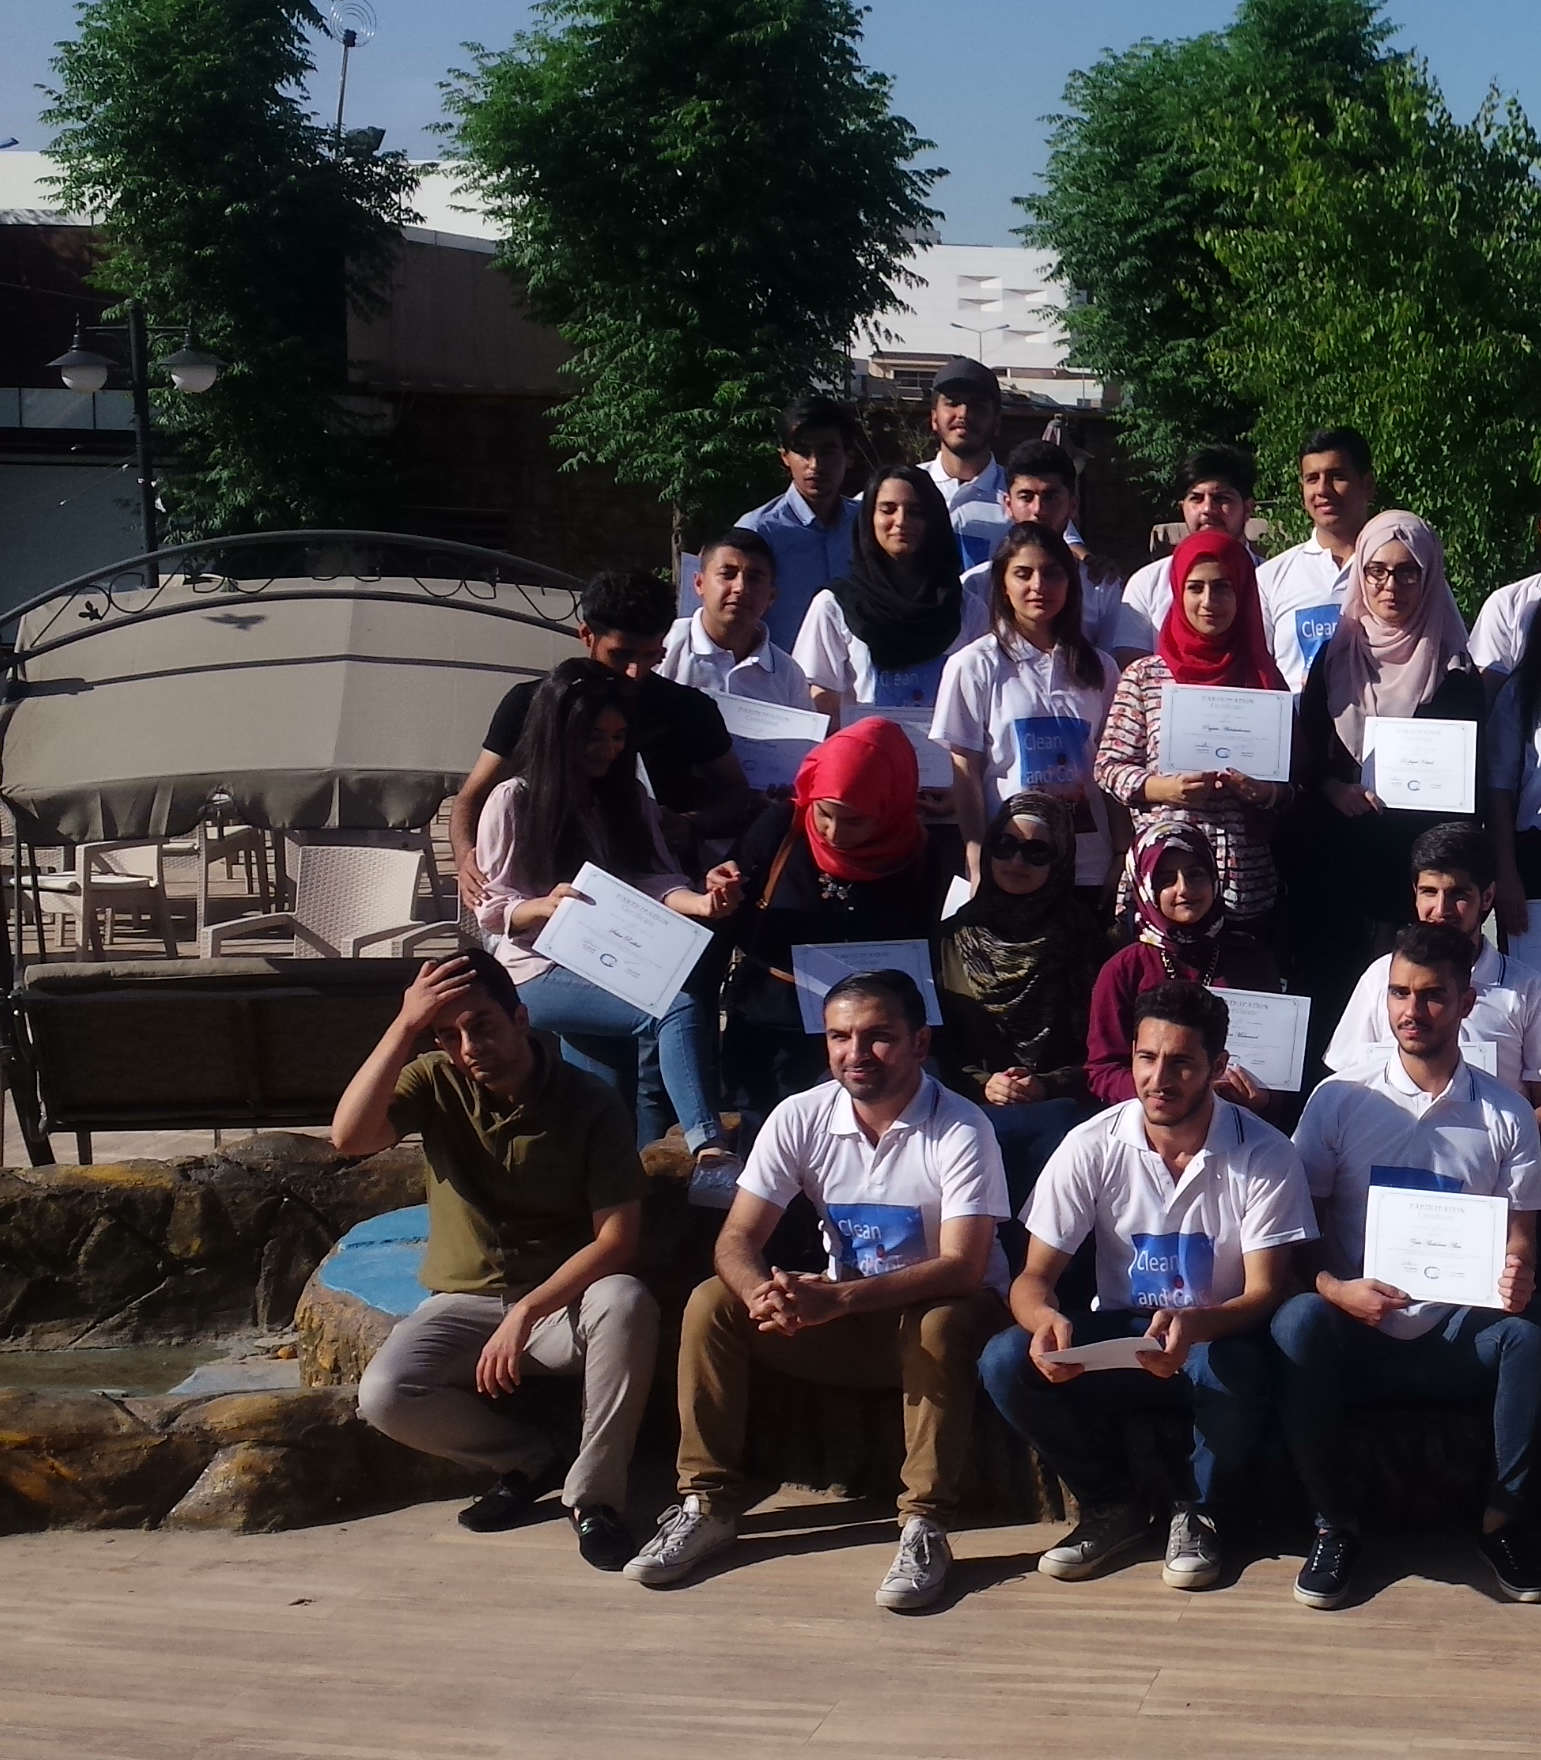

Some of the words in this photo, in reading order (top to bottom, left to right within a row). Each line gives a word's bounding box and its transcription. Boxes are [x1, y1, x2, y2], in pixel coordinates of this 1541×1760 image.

[838, 1219, 881, 1241] Clean
[1136, 1251, 1179, 1273] Clean
[1138, 1288, 1167, 1307] and
